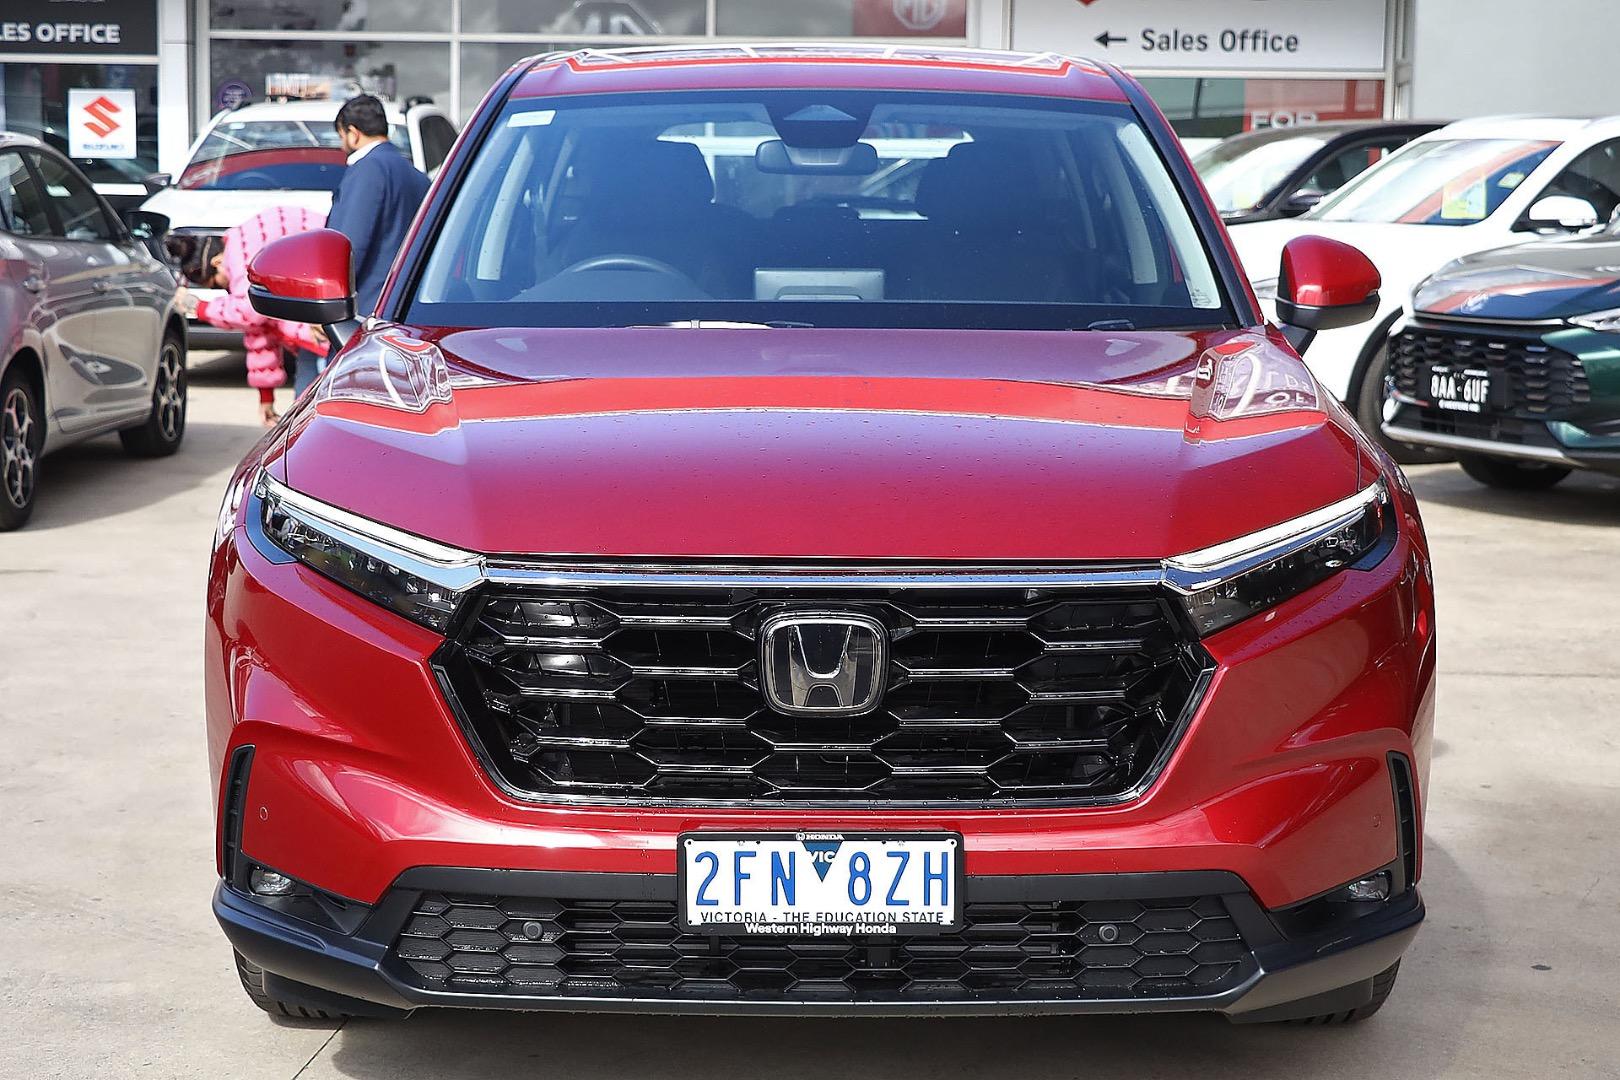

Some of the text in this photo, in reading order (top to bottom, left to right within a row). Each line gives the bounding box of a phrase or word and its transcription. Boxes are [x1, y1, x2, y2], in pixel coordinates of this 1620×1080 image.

[0, 22, 121, 43] ES OFFICE
[1141, 28, 1298, 52] Sales Office
[807, 850, 836, 863] VIC
[694, 851, 948, 906] 2FN 8ZH
[701, 911, 766, 923] VICTORIA
[783, 911, 810, 923] THE
[816, 911, 897, 923] EDUCATION
[902, 911, 944, 923] STATE
[744, 923, 896, 936] Western Highway Honda
